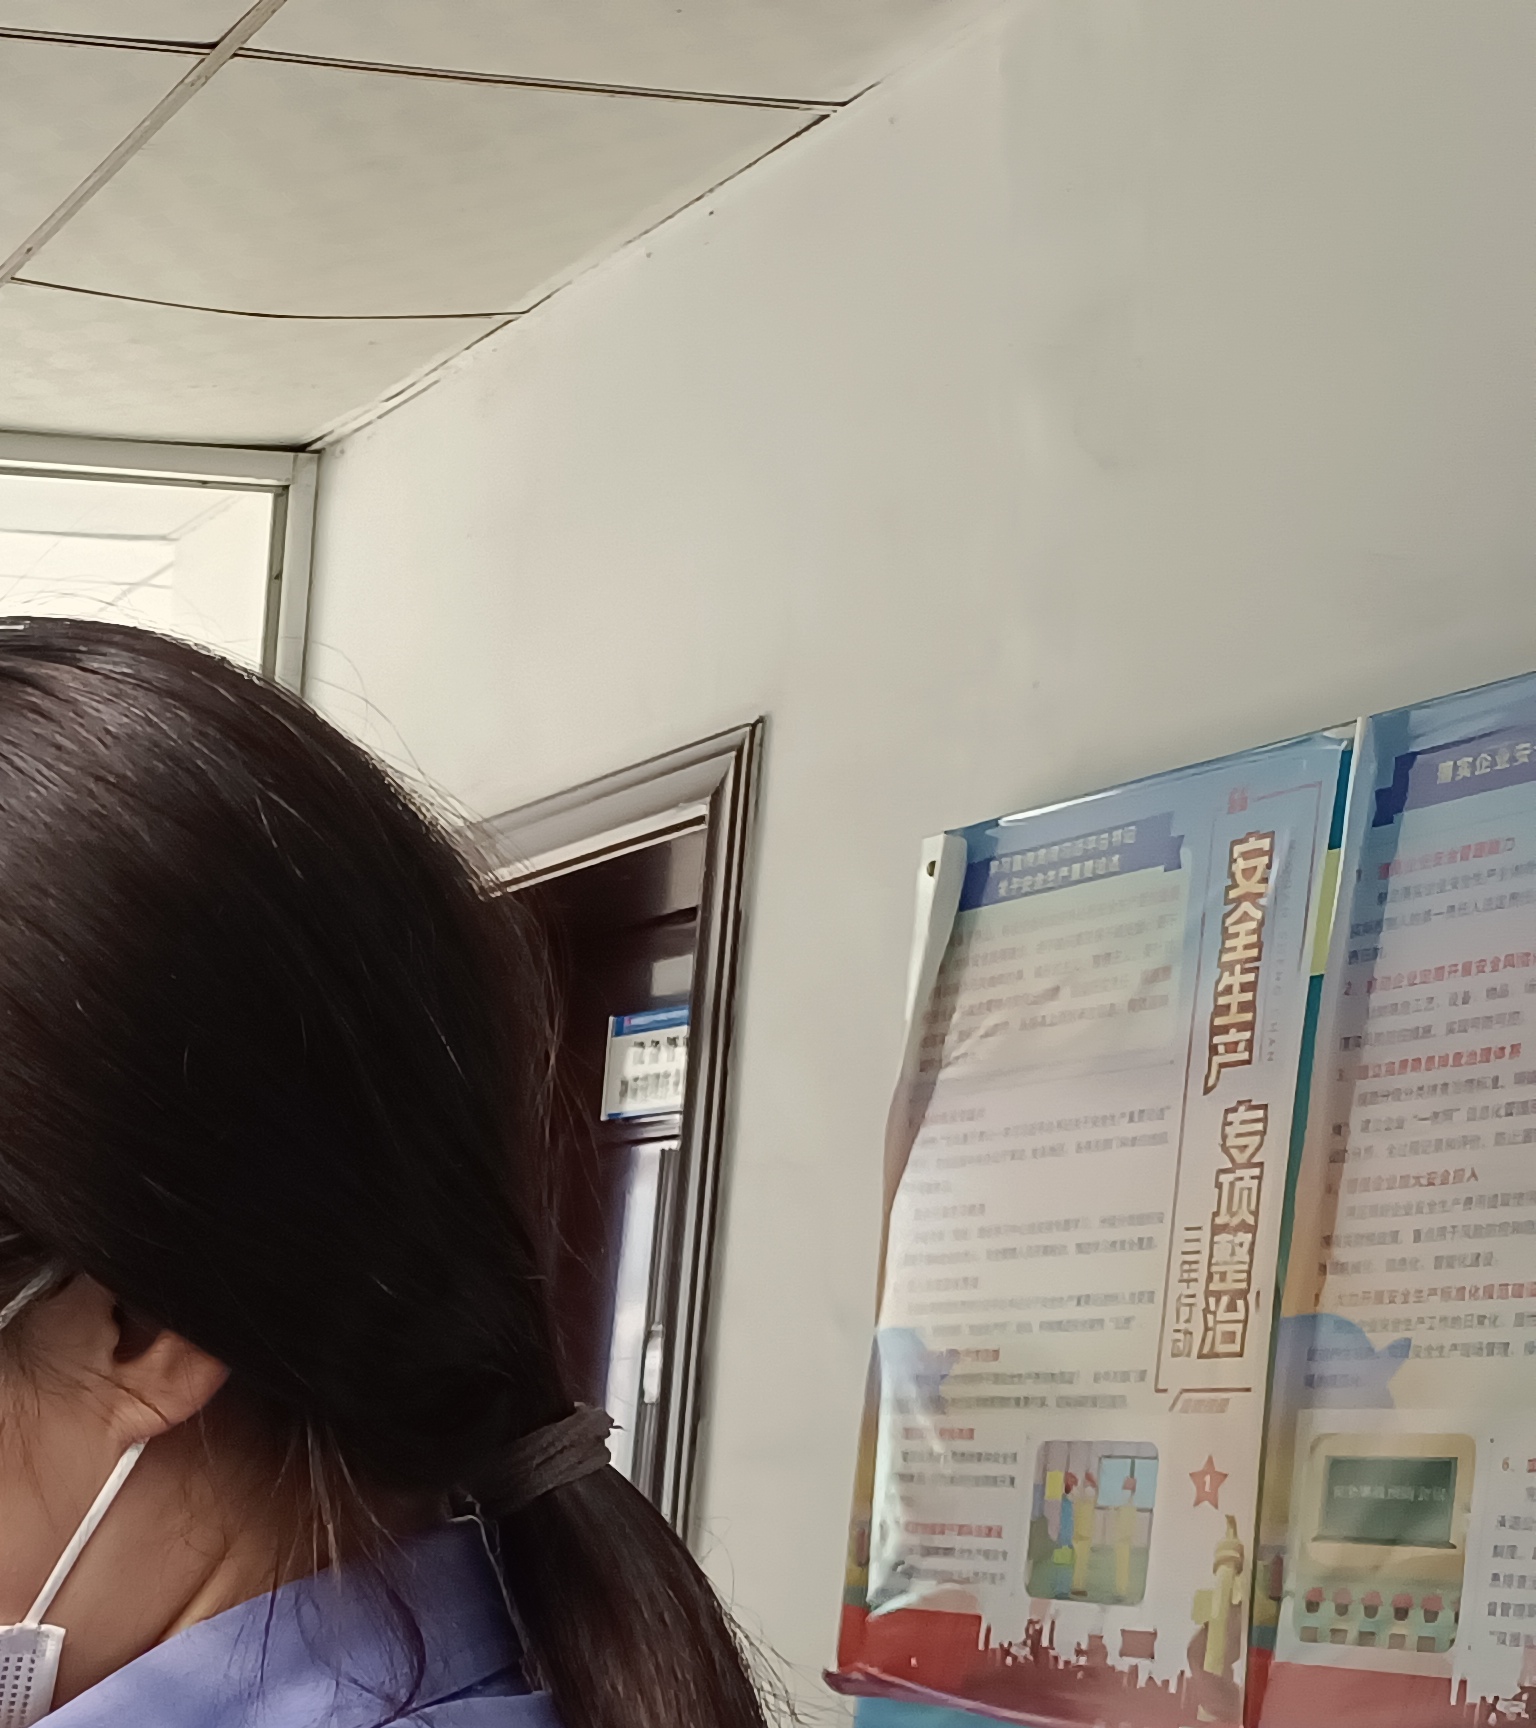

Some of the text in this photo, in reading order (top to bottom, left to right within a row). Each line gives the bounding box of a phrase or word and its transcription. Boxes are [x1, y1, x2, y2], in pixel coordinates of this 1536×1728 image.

[1196, 829, 1275, 1361] 安全生产 专项整治
[1171, 1226, 1203, 1358] 三年行动
